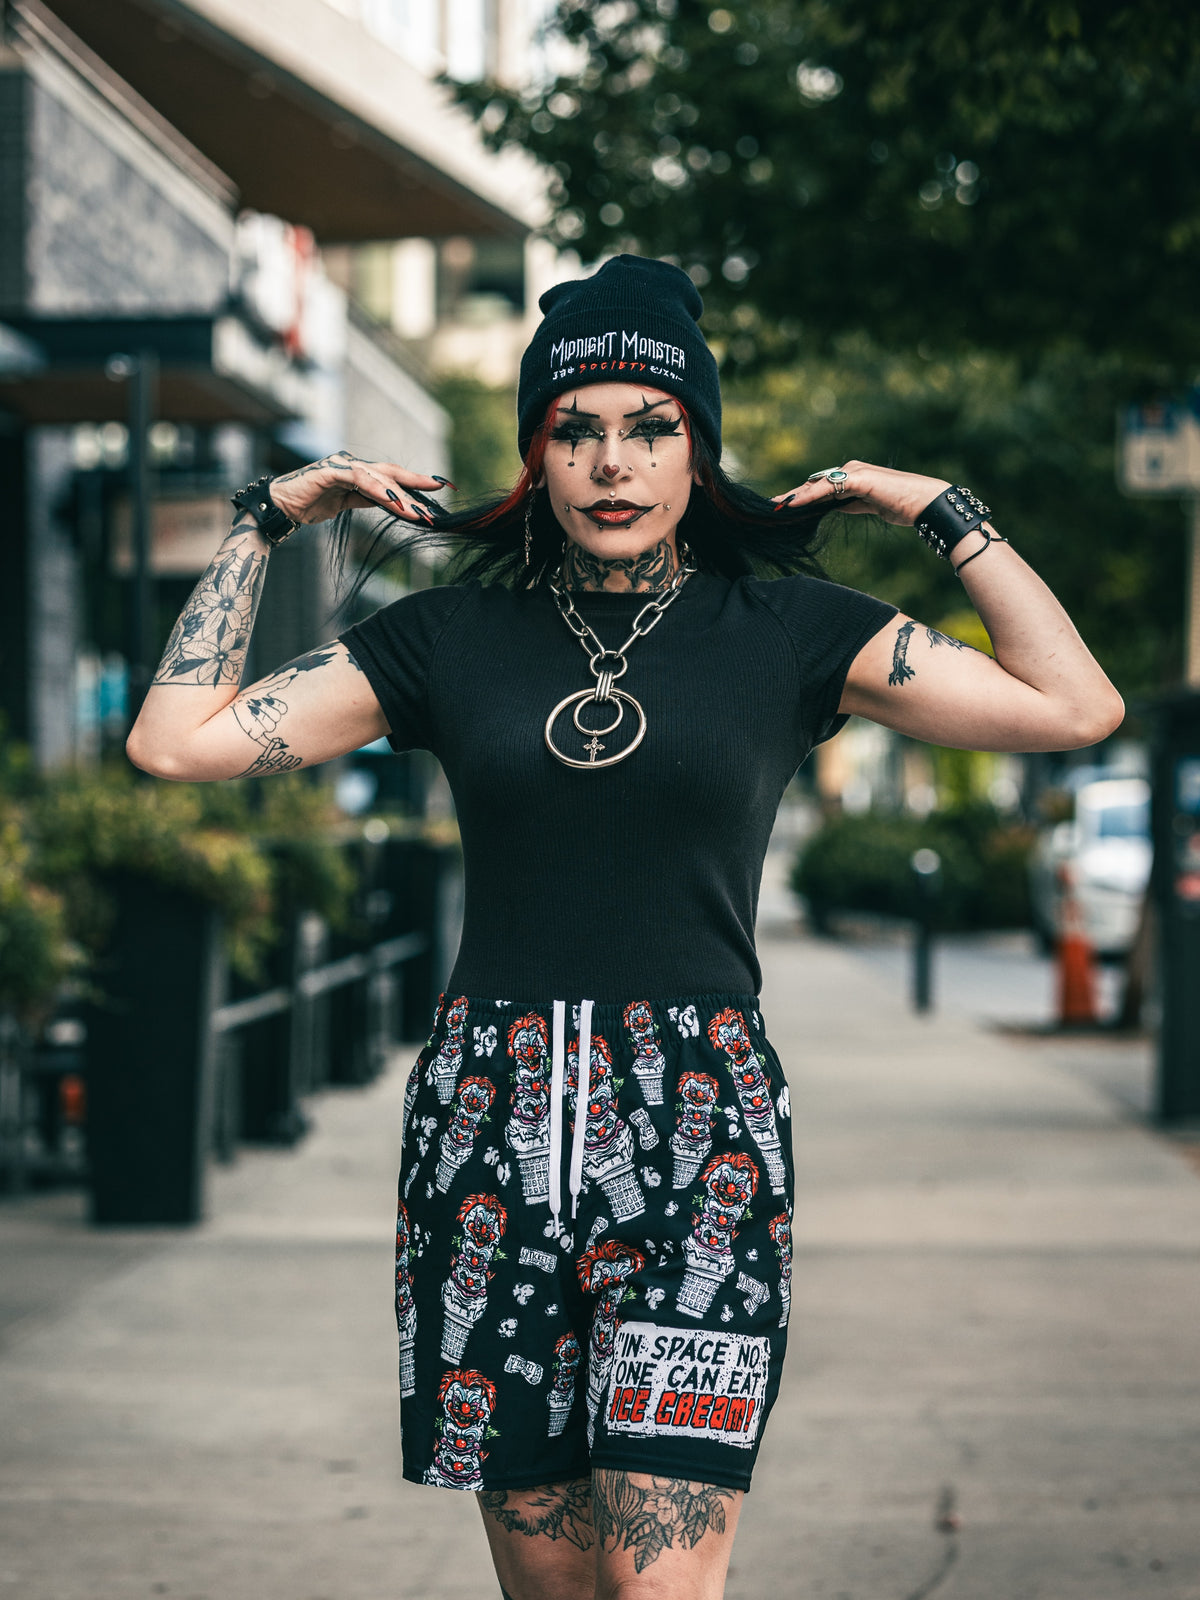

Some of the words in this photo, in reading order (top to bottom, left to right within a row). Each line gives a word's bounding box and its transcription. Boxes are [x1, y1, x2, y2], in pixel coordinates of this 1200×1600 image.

[579, 360, 646, 374] SOCIETY
[621, 330, 686, 370] MONSTER
[650, 1335, 730, 1366] SPACE
[736, 1343, 761, 1369] NO
[615, 1360, 658, 1386] ONE
[667, 1365, 721, 1392] CAN
[727, 1371, 762, 1396] EAT
[608, 1386, 652, 1423] ICE
